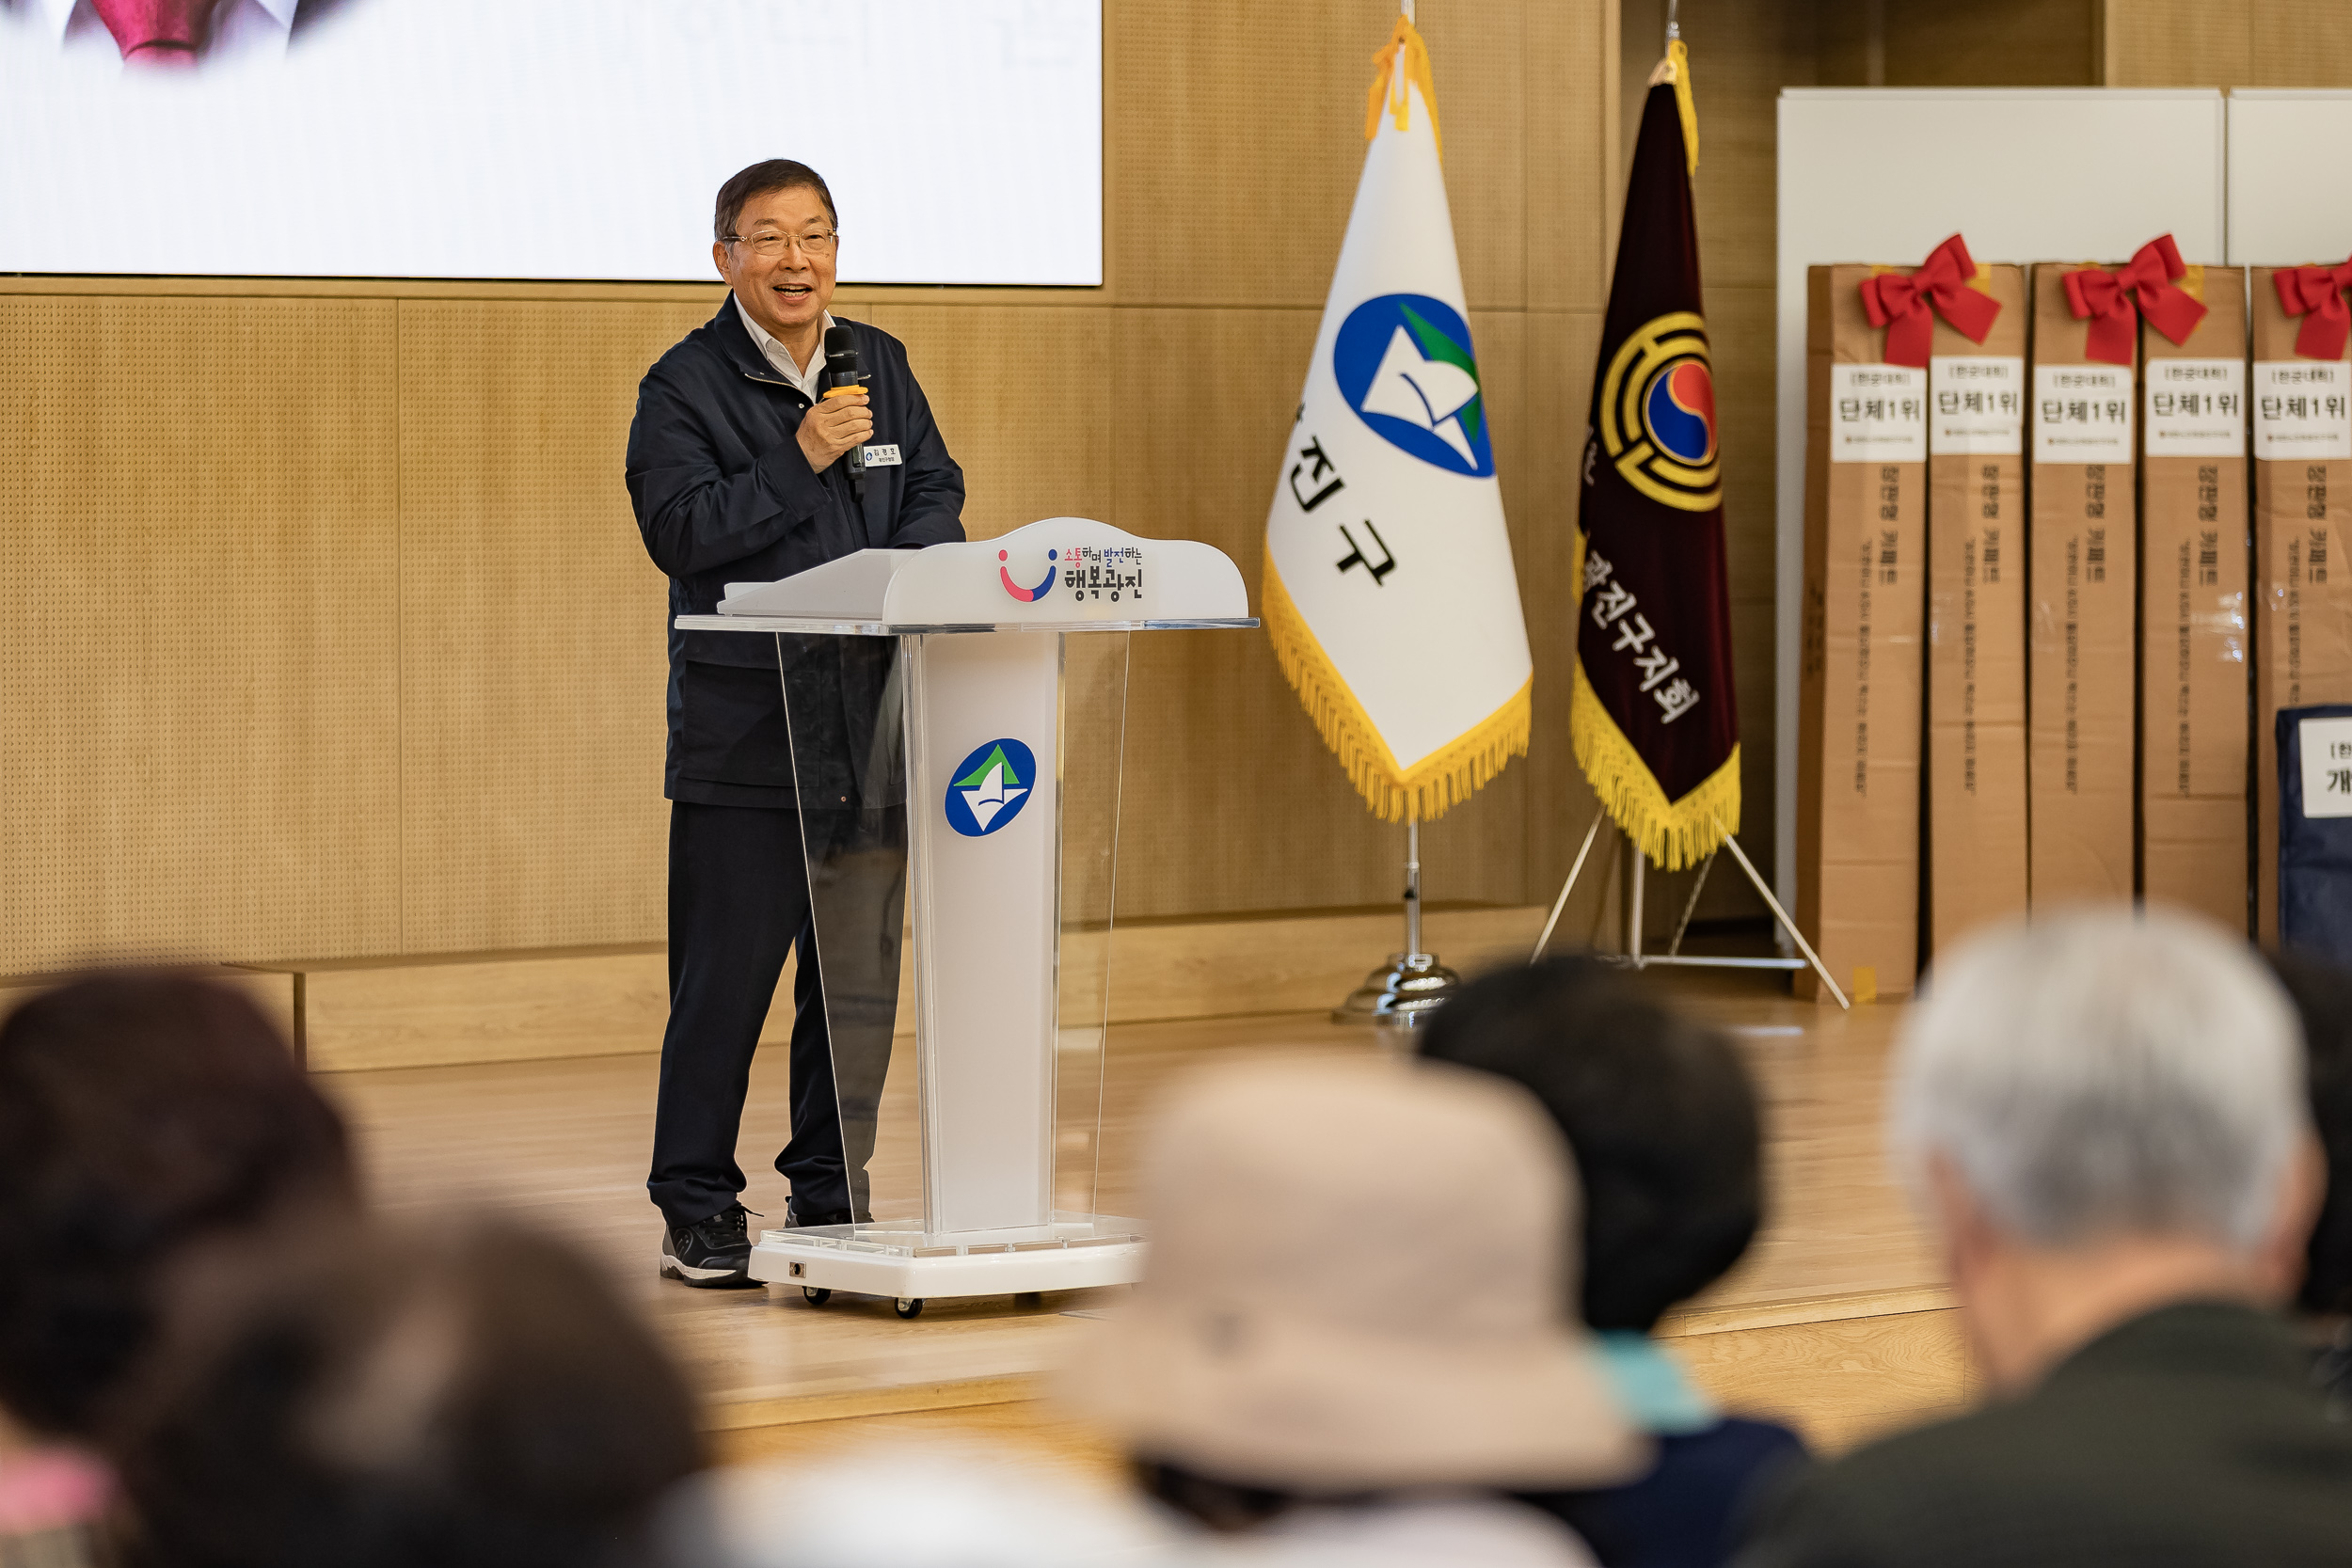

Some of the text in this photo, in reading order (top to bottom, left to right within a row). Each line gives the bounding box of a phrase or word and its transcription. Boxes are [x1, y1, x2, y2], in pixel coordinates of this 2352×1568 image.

[1840, 397, 1920, 421] 단체1위
[1939, 390, 2018, 416] 단체1위
[2042, 399, 2125, 423] 단체1위
[2153, 391, 2238, 417] 단체1위
[2261, 395, 2345, 420] 단체1위
[1290, 402, 1397, 587] 진구
[1064, 546, 1143, 568] 소통하며 발전하는
[1064, 565, 1143, 603] 행복광진
